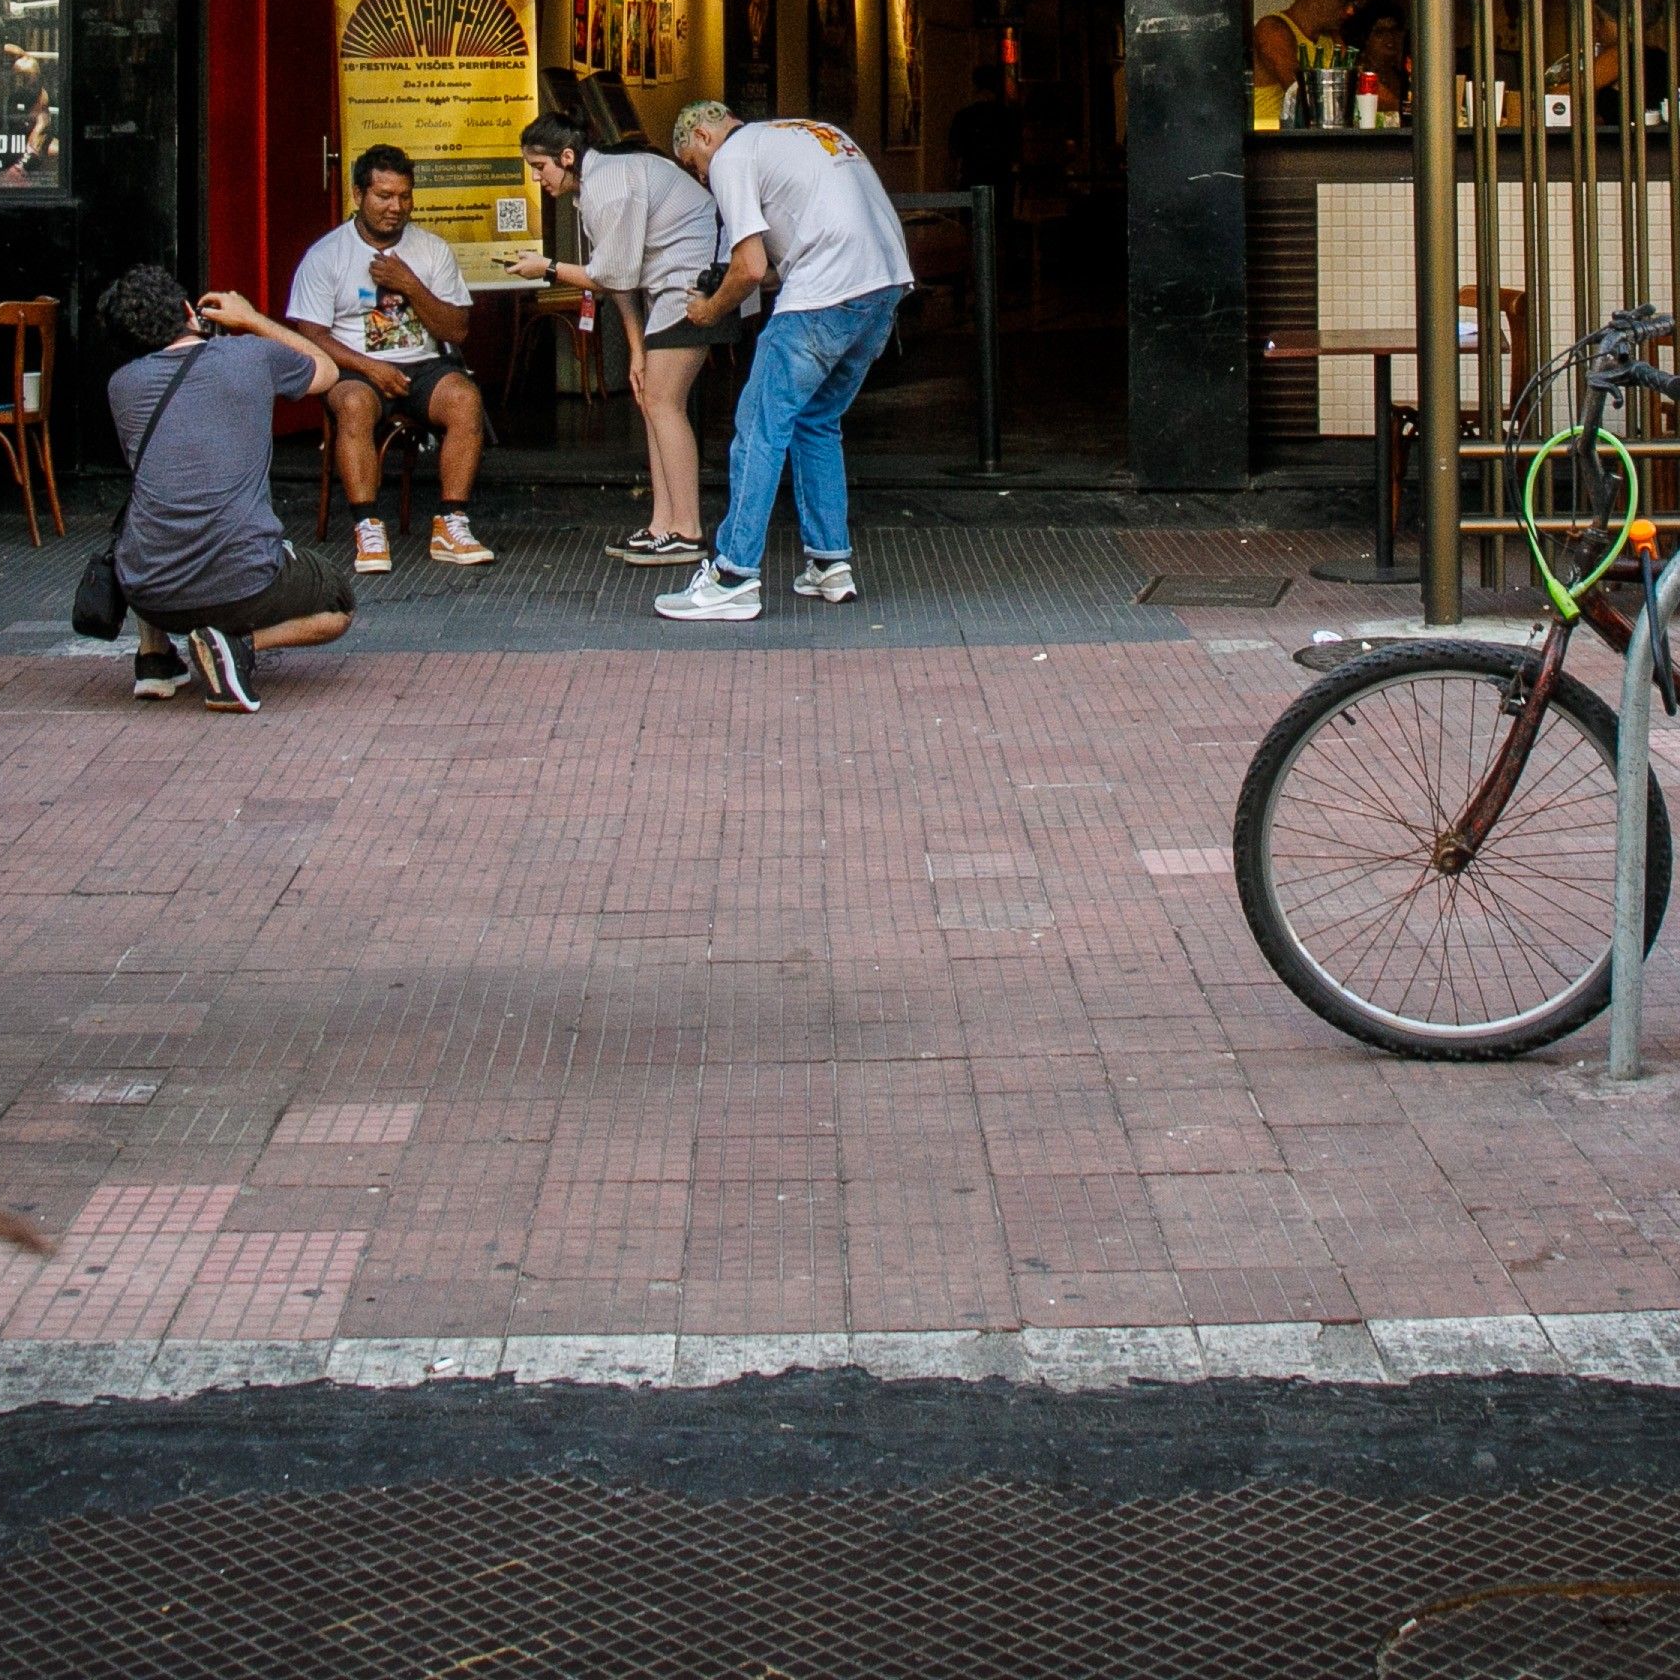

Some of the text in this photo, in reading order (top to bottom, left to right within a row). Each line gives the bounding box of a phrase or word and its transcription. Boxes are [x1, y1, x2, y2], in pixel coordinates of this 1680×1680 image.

[359, 62, 412, 71] FESTIVAL
[415, 59, 455, 70] VISÕES
[458, 58, 526, 70] PERIFÉRICAS
[11, 134, 26, 154] III
